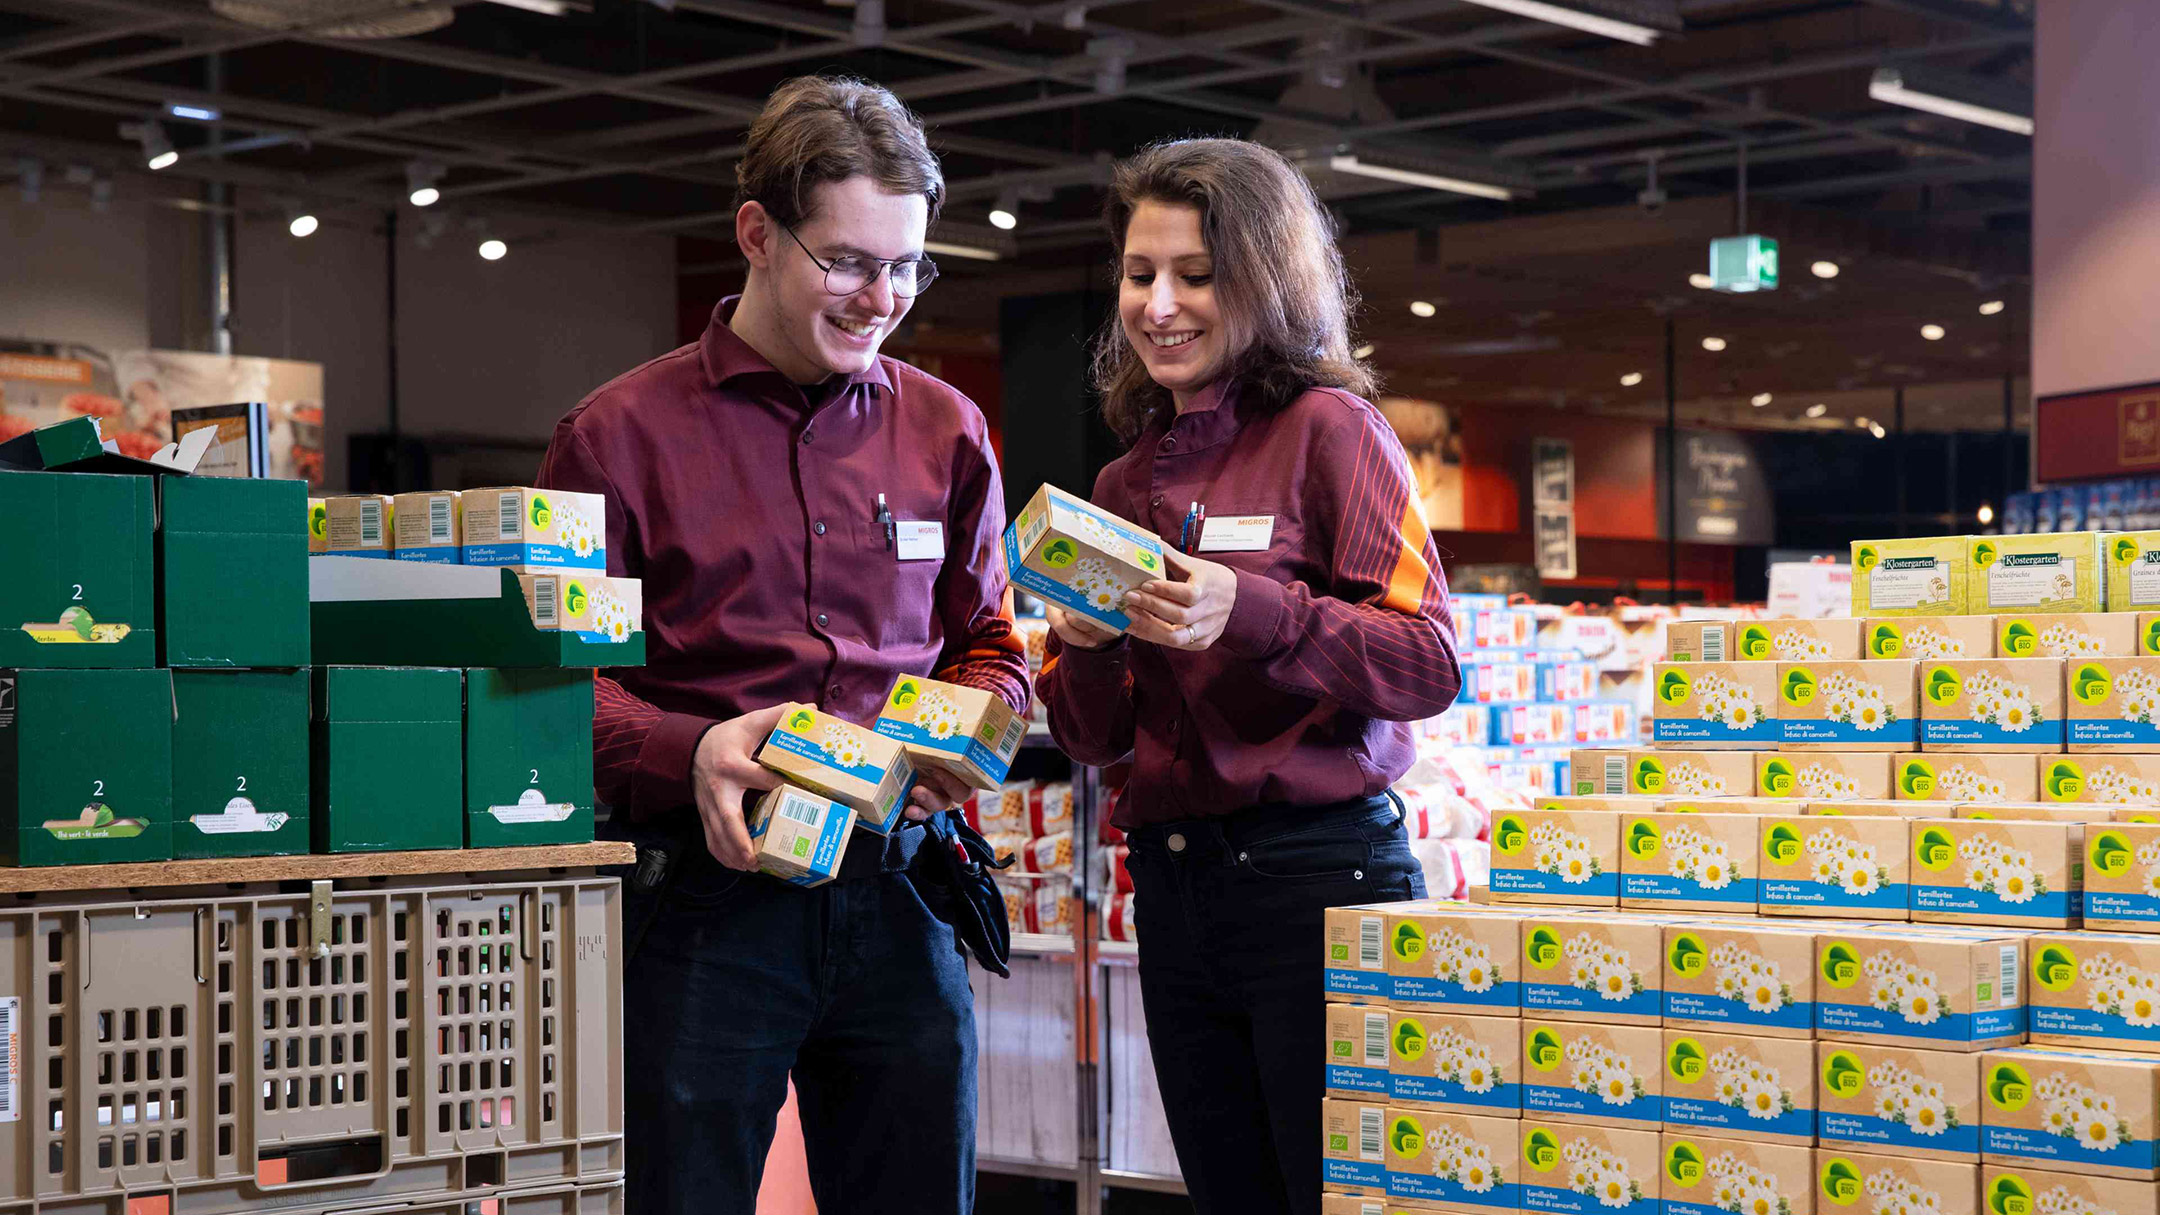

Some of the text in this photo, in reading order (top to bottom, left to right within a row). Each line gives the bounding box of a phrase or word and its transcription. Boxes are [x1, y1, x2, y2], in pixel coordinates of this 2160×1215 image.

[1886, 559, 1933, 568] Klostergarten
[2006, 555, 2057, 566] Klostergarten
[72, 584, 83, 600] 2
[1798, 689, 1810, 697] BIO
[1942, 689, 1955, 697] BIO
[2090, 687, 2104, 695] BIO
[1784, 724, 1814, 732] Kamillentee
[2075, 724, 2109, 732] Kamillentee
[530, 769, 538, 783] 2
[93, 780, 104, 796] 2
[237, 776, 246, 792] 2
[1777, 780, 1789, 788] BIO
[1509, 838, 1521, 846] BIO
[1642, 842, 1655, 850] BIO
[1782, 847, 1795, 856] BIO
[1934, 852, 1948, 861] BIO
[2110, 858, 2125, 866] BIO
[1496, 873, 1524, 882] Kamillentee
[1496, 879, 1511, 887] Infuso
[1628, 878, 1658, 888] Kamillentee
[1766, 884, 1800, 893] Kamillentee
[1766, 890, 1784, 899] Infuso
[1786, 892, 1792, 900] di
[1918, 890, 1952, 900] Kamillentee
[1918, 898, 1937, 906] Infuso
[1938, 898, 1944, 906] di
[2093, 896, 2130, 907] Kamillentee
[2092, 905, 2113, 914] Infuso
[2114, 906, 2121, 914] di
[1407, 945, 1419, 953] BIO
[1687, 959, 1700, 968] BIO
[1331, 973, 1358, 981] Kamillentee
[1839, 969, 1853, 978] BIO
[2054, 972, 2069, 981] BIO
[1395, 980, 1423, 990] Kamillentee
[1395, 988, 1410, 996] Infuso
[1671, 997, 1704, 1007] Kamillentee
[1671, 1005, 1688, 1013] Infuso
[1824, 1008, 1858, 1018] Kamillentee
[1824, 1016, 1842, 1024] Infuso
[2038, 1011, 2074, 1022] Kamillentee
[2038, 1020, 2058, 1028] Infuso
[1408, 1043, 1420, 1051] BIO
[1333, 1069, 1362, 1079] Kamillentee
[1395, 1079, 1424, 1088] Kamillentee
[1843, 1078, 1857, 1088] BIO
[2008, 1091, 2023, 1101] BIO
[1827, 1117, 1862, 1128] Kamillentee
[1827, 1125, 1846, 1134] Infuso
[1991, 1130, 2028, 1142] Kamillentee
[1991, 1140, 2010, 1149] Infuso
[2013, 1142, 2019, 1150] di
[1330, 1164, 1358, 1172] Kamillentee
[1684, 1169, 1697, 1177] BIO
[1841, 1186, 1855, 1195] BIO
[2009, 1203, 2025, 1213] BIO
